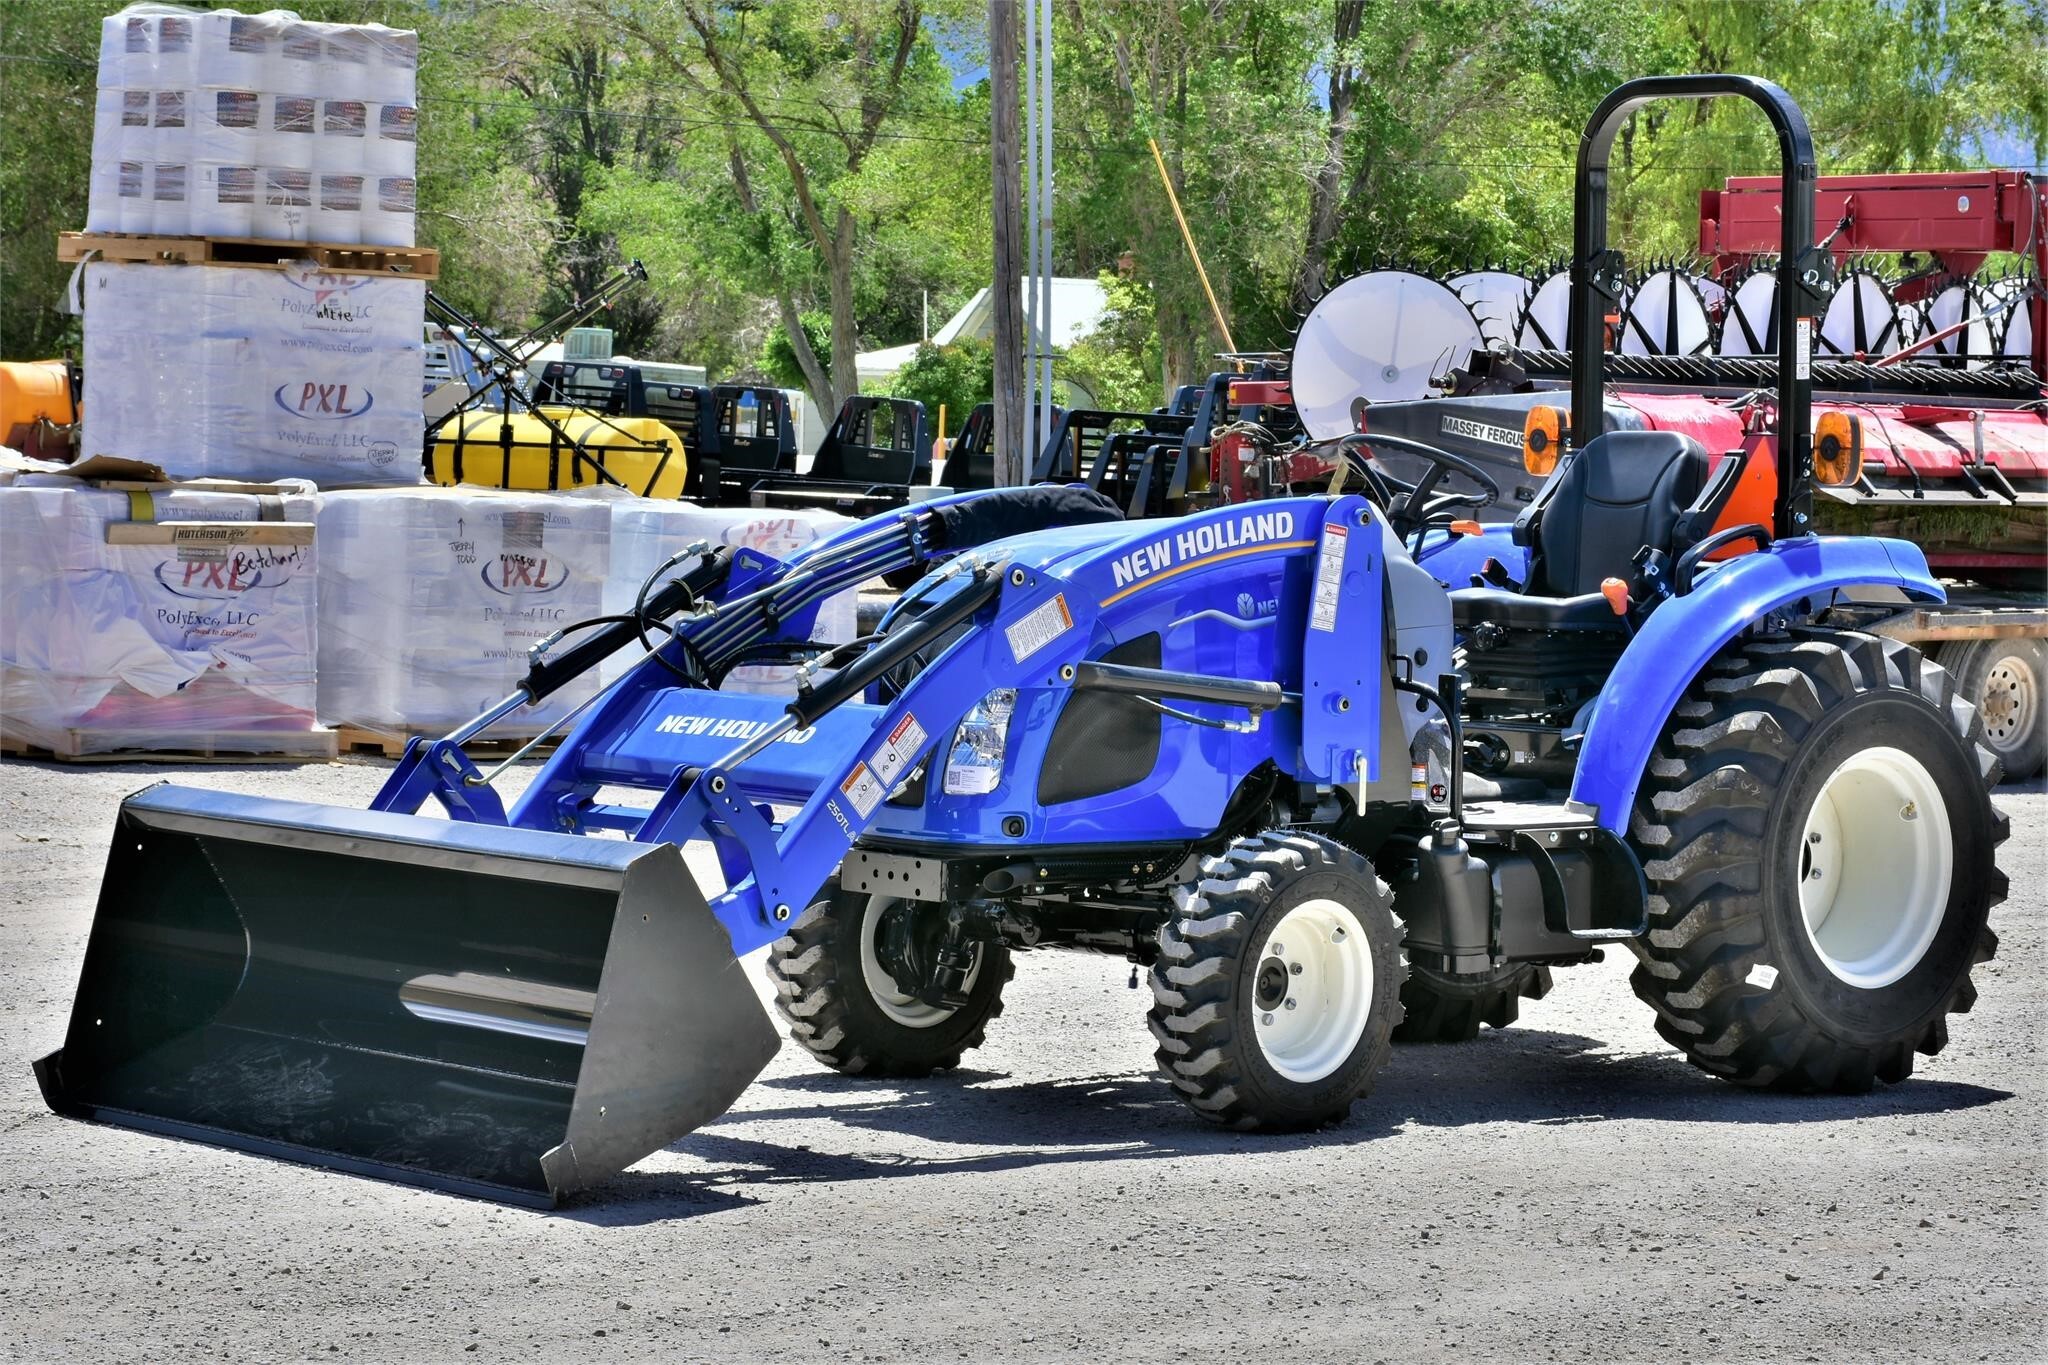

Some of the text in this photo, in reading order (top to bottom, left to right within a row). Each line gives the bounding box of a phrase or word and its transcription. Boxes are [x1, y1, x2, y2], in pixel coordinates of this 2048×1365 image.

[298, 382, 352, 414] PXL
[1442, 416, 1485, 438] MASSEY
[177, 529, 227, 539] HUTCHISON
[1111, 511, 1294, 588] NEW HOLLAND
[183, 559, 246, 591] PXL
[503, 558, 549, 588] PXL
[227, 610, 260, 626] LLC
[655, 714, 817, 744] NEW HOLLND
